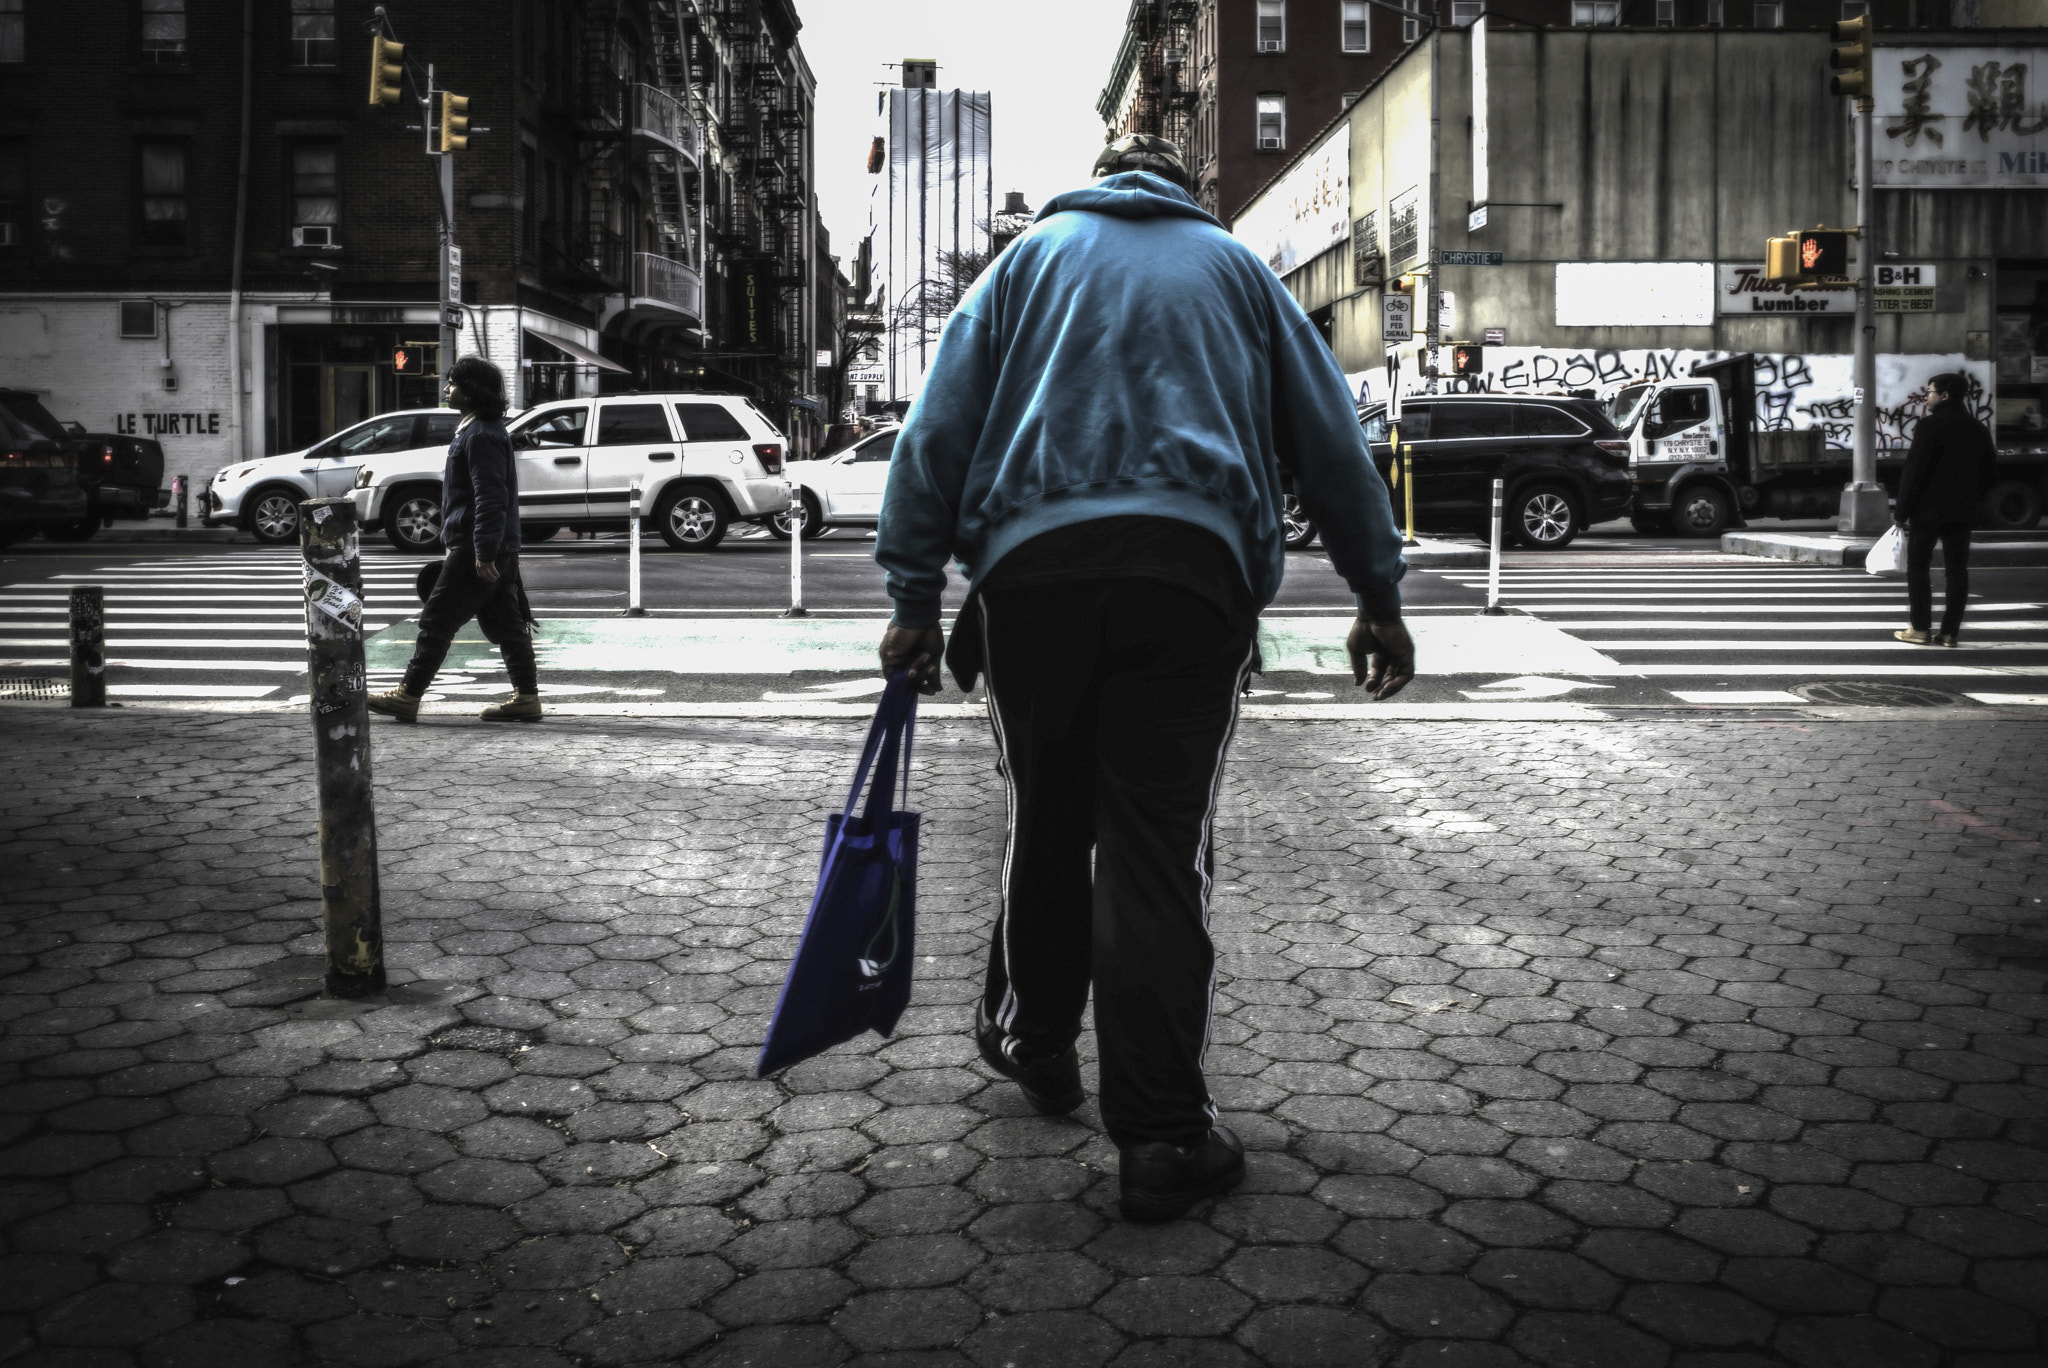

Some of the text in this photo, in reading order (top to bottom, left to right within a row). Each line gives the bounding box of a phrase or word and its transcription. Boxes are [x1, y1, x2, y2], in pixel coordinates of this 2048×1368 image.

[1997, 151, 2048, 174] Mik
[1442, 252, 1490, 265] CHRYSTIE
[1878, 266, 1920, 285] B&H
[1873, 287, 1934, 296] ASHING CEMENT
[746, 275, 758, 343] SUITES
[1752, 296, 1830, 312] Lumber
[1873, 299, 1900, 310] ETTER
[1910, 299, 1934, 310] BEST
[117, 413, 220, 434] LE TURTLE
